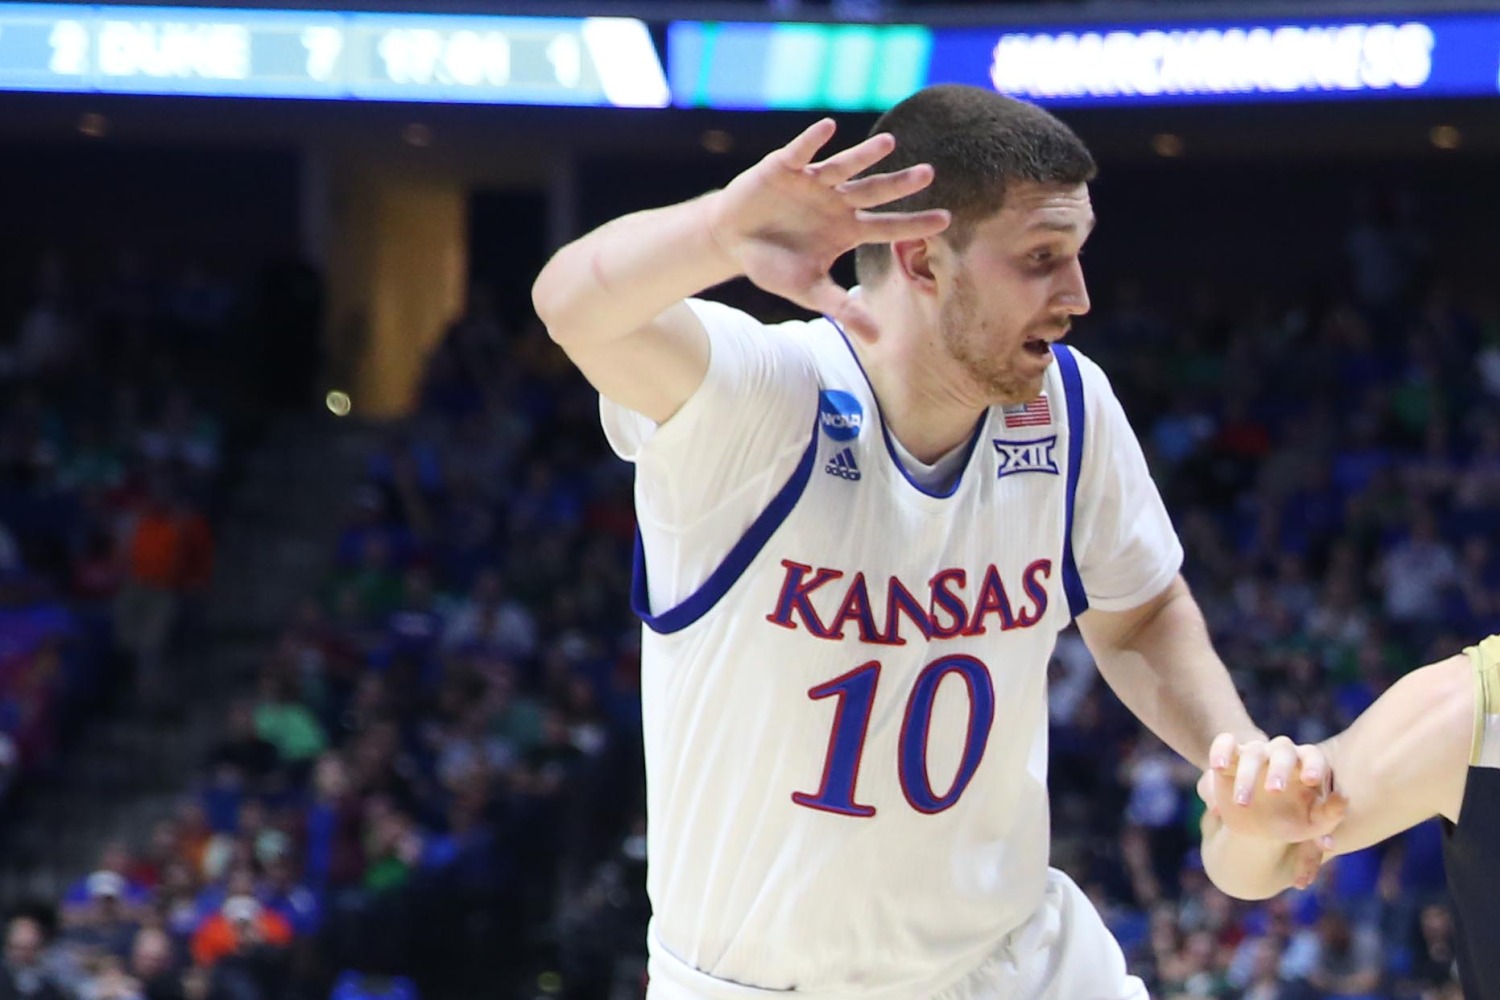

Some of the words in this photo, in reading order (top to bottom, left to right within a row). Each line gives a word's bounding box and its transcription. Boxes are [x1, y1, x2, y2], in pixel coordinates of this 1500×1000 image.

[99, 21, 250, 80] DUKE
[821, 411, 862, 429] NCAA
[766, 559, 1052, 646] KANSAS
[791, 653, 995, 818] 10
